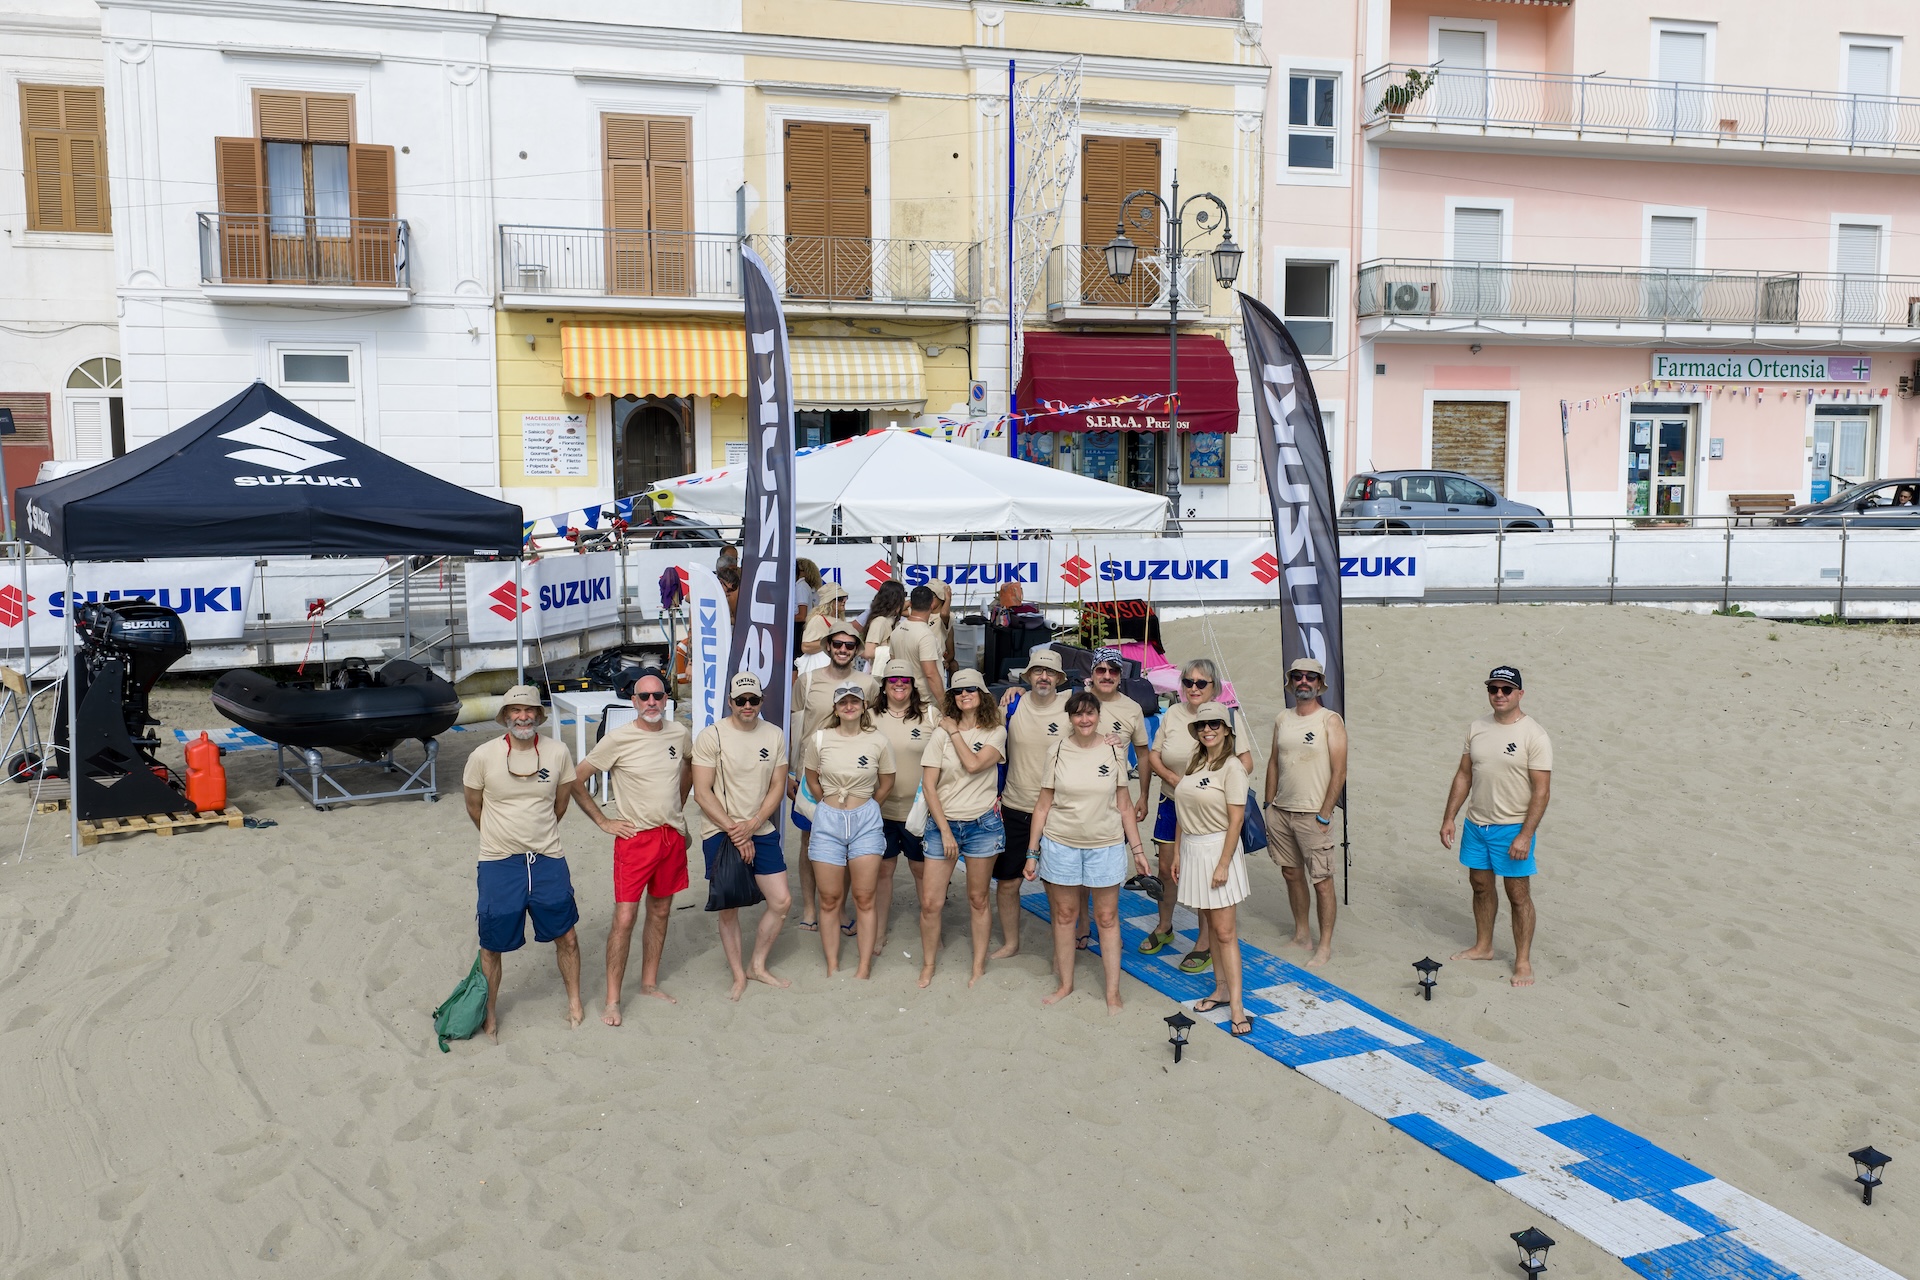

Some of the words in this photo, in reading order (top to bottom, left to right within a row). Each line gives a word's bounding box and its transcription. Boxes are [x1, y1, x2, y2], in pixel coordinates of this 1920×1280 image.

[1657, 356, 1742, 378] Farmacia
[1748, 358, 1826, 379] Ortensia
[1086, 415, 1142, 428] S.E.R.A.
[1145, 416, 1190, 429] PREZOSI
[233, 474, 362, 488] SUZUKI
[905, 562, 1038, 587] SUZUKI
[1099, 559, 1228, 581] SUZUKI
[1340, 556, 1416, 577] ZUKI
[539, 576, 611, 611] SUZUKI
[122, 620, 170, 630] SUZUKI
